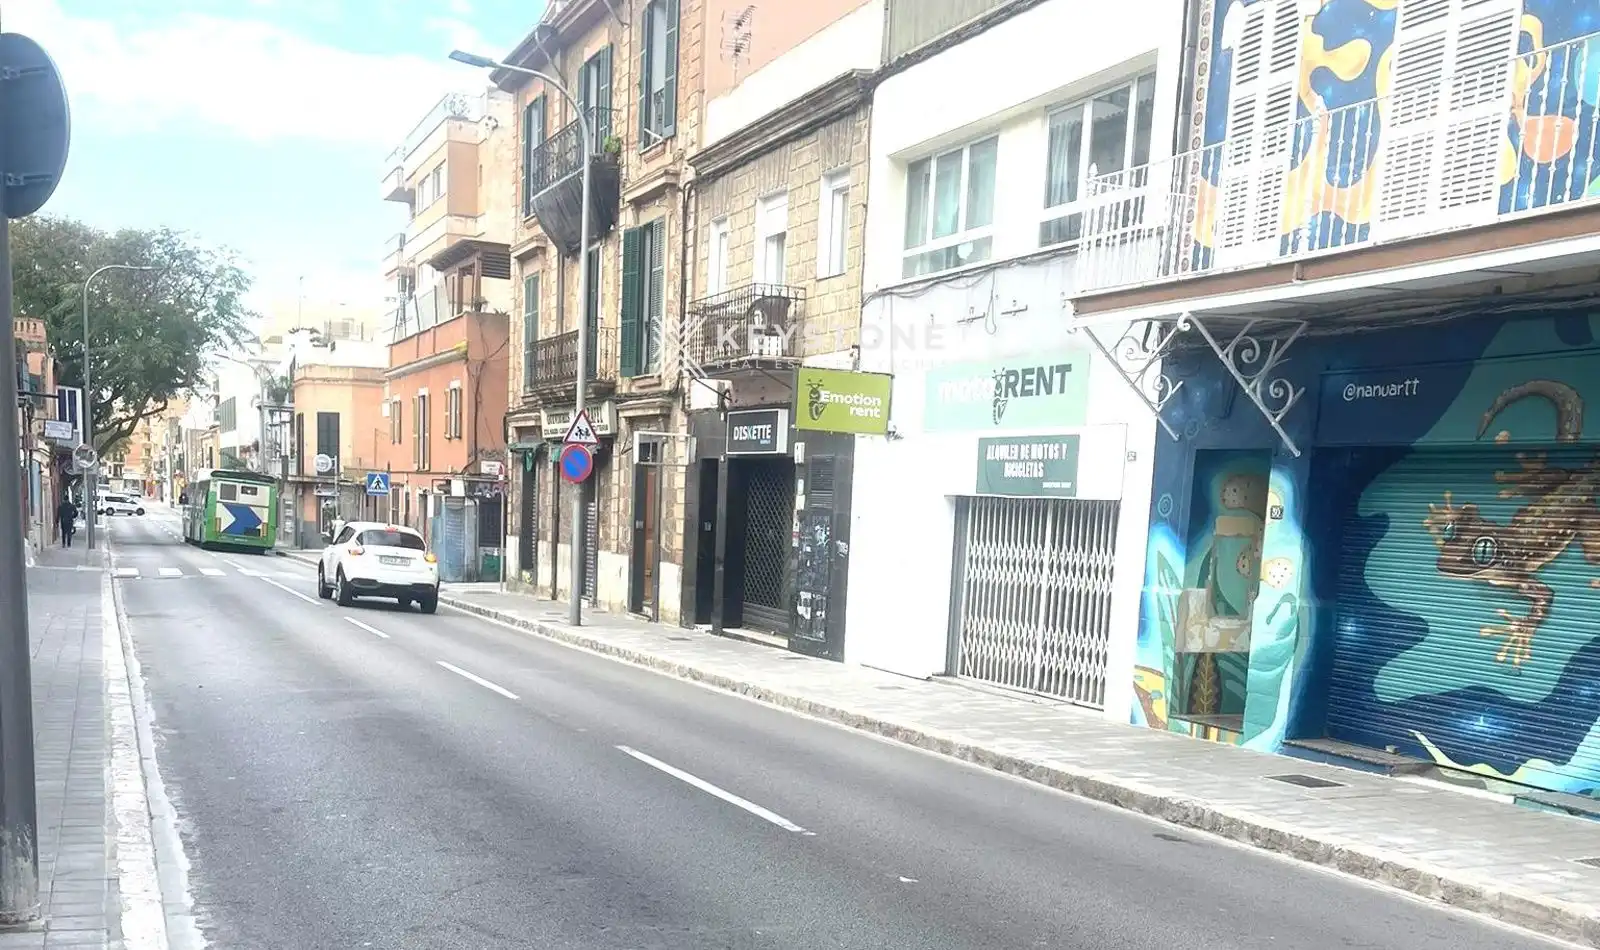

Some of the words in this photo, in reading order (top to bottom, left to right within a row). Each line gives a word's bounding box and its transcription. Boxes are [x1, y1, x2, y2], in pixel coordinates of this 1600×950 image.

[1004, 363, 1072, 398] RENT
[820, 390, 881, 406] Emotion
[850, 406, 880, 418] rent
[733, 424, 771, 441] DISKETTE
[986, 444, 1018, 461] ALQUILER
[1020, 444, 1030, 460] DE
[1031, 443, 1060, 460] MOTOS
[1062, 443, 1068, 460] Y
